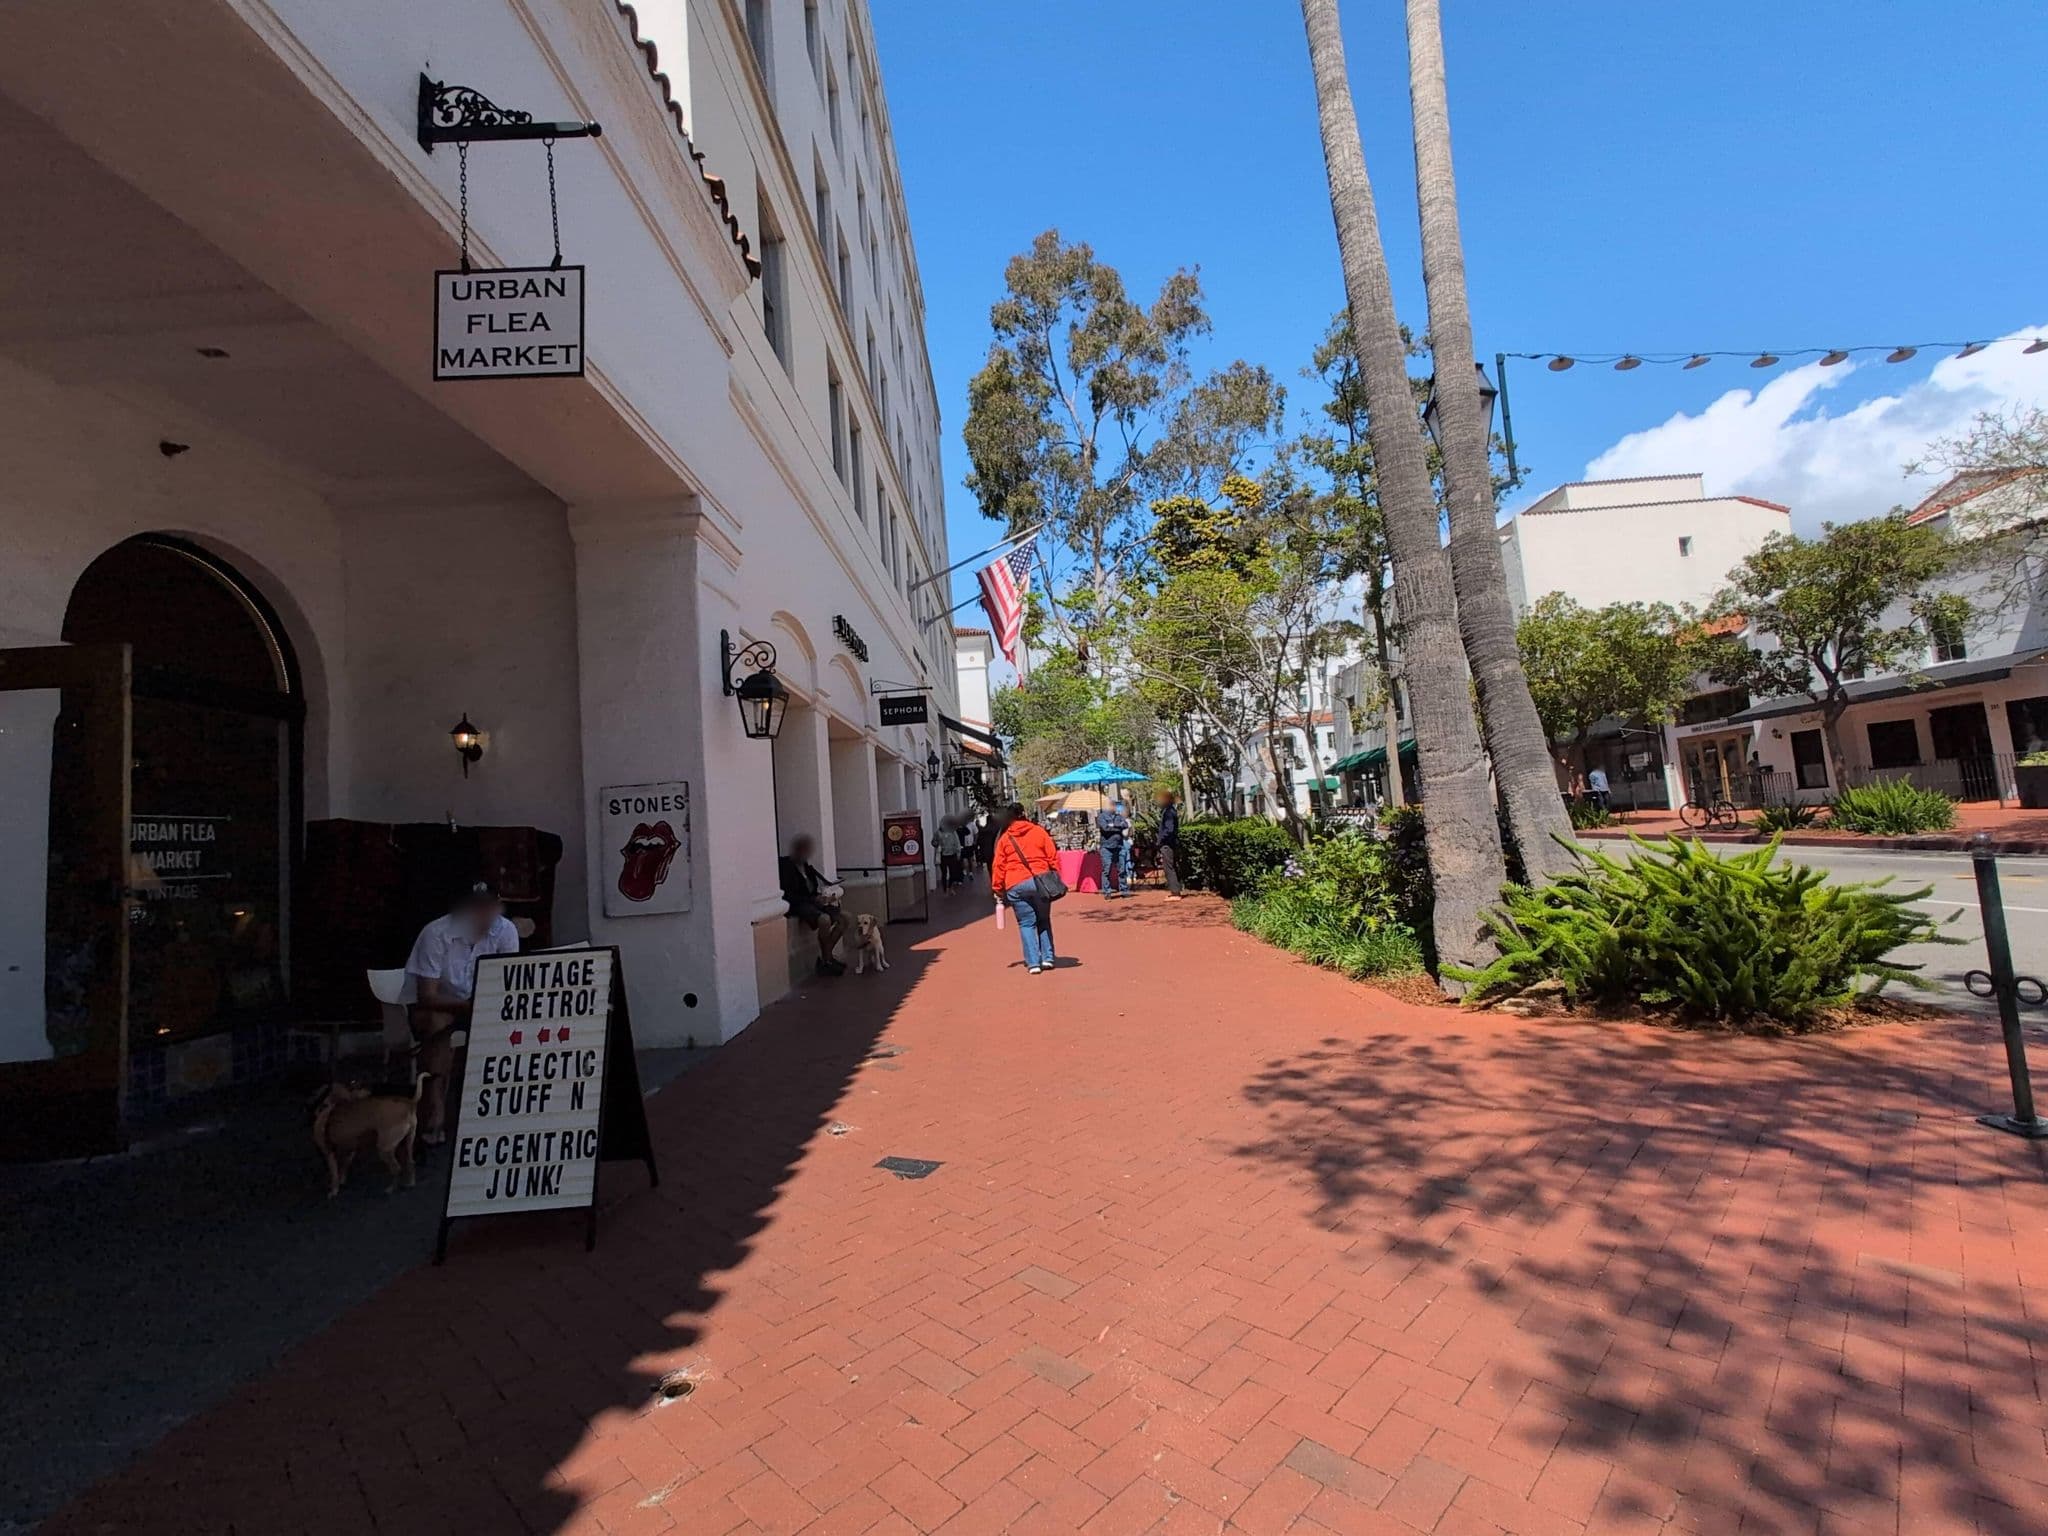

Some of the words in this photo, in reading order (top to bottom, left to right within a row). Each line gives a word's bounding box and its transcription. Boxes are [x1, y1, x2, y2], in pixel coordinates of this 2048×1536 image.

[452, 277, 566, 301] URBAN
[467, 312, 551, 334] FLEA
[440, 344, 578, 369] MARKET
[883, 706, 924, 716] SEPHORA
[961, 770, 977, 785] BR
[609, 795, 686, 815] STONES
[182, 823, 216, 841] FLEA
[143, 850, 202, 870] MARKET
[503, 959, 595, 991] VINTAGE
[501, 988, 597, 1021] &RETRO!
[483, 1050, 596, 1084] ECLECTIC
[477, 1083, 553, 1117] STUFF
[570, 1081, 586, 1111] N
[486, 1164, 563, 1200] JUNK!
